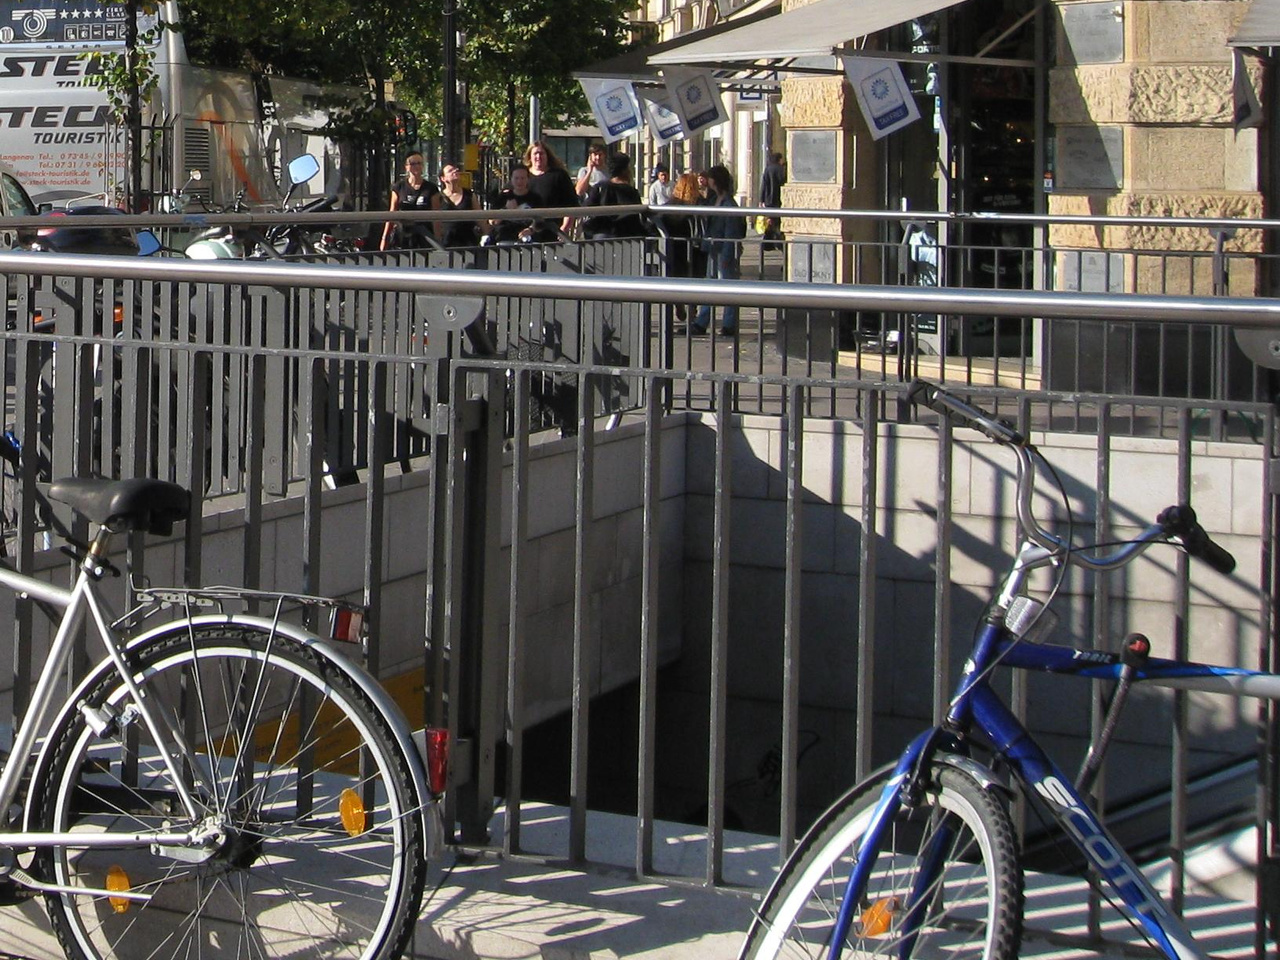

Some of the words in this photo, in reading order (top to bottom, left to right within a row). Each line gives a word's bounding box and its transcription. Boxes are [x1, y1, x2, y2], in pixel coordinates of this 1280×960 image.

[33, 132, 124, 144] TOURISTIK
[39, 161, 54, 169] Tel.:
[1033, 775, 1169, 918] SCOTT
